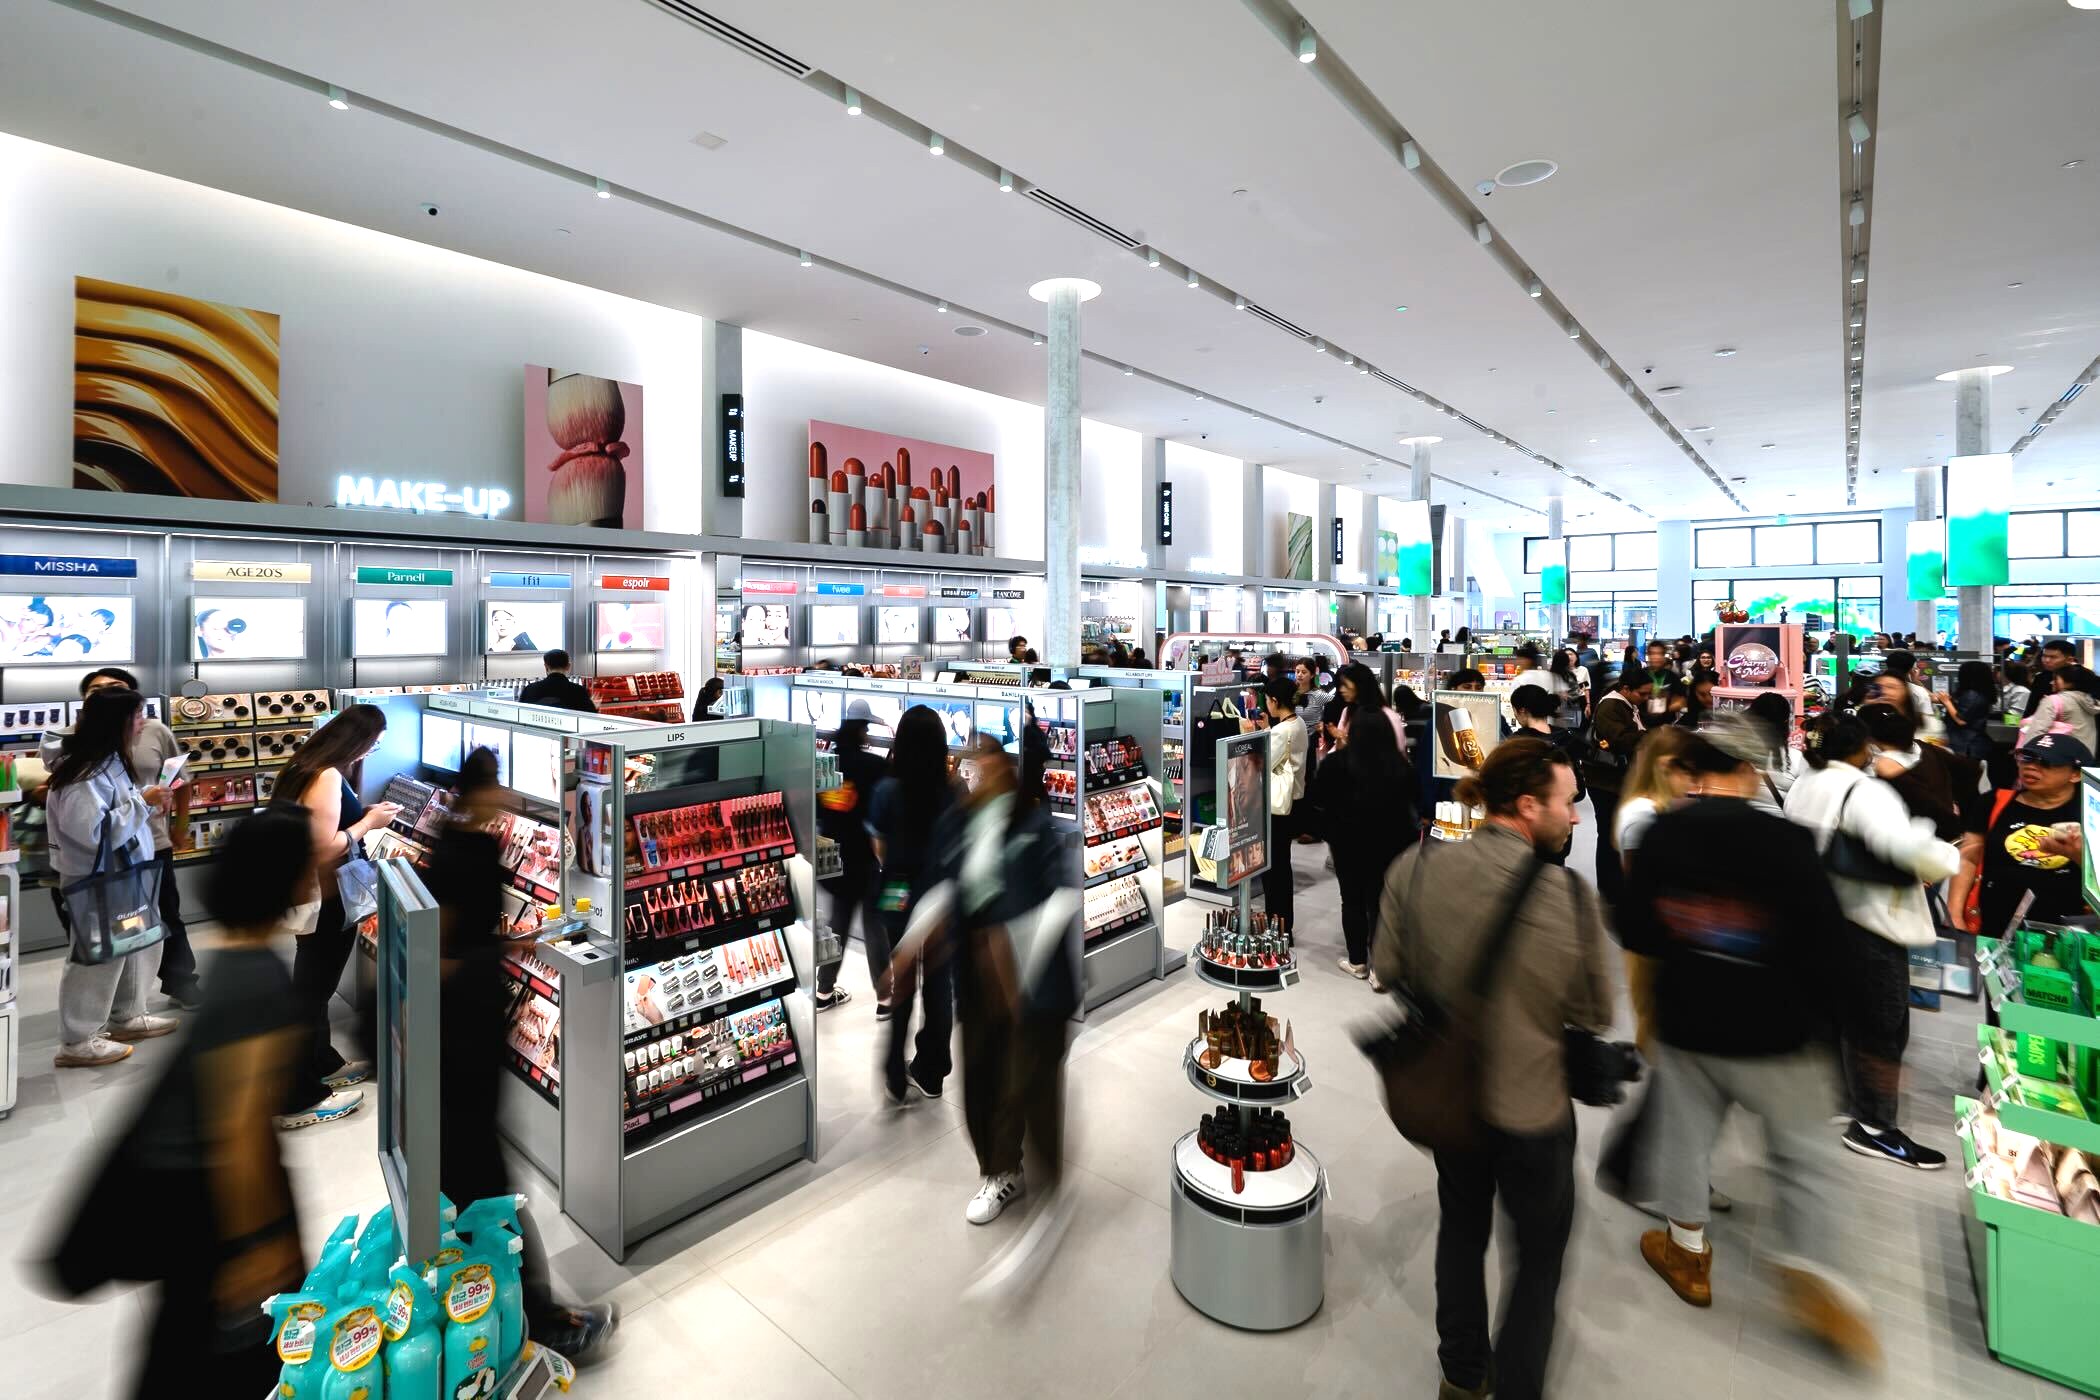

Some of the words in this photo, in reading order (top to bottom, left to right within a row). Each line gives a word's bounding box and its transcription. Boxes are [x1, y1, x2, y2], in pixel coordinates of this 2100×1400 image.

[728, 429, 738, 462] MAKEUP
[337, 475, 510, 515] MAKE-UP
[34, 561, 99, 573] MISSHA
[226, 566, 283, 579] AGE20'S
[387, 571, 425, 584] Parnell
[622, 576, 650, 589] espoir
[996, 590, 1021, 599] LANCÔME
[1727, 654, 1767, 669] Charm
[667, 733, 685, 742] LIPS
[2025, 988, 2068, 1004] MATCHA
[468, 1283, 490, 1298] 99%
[353, 1324, 377, 1344] 99%
